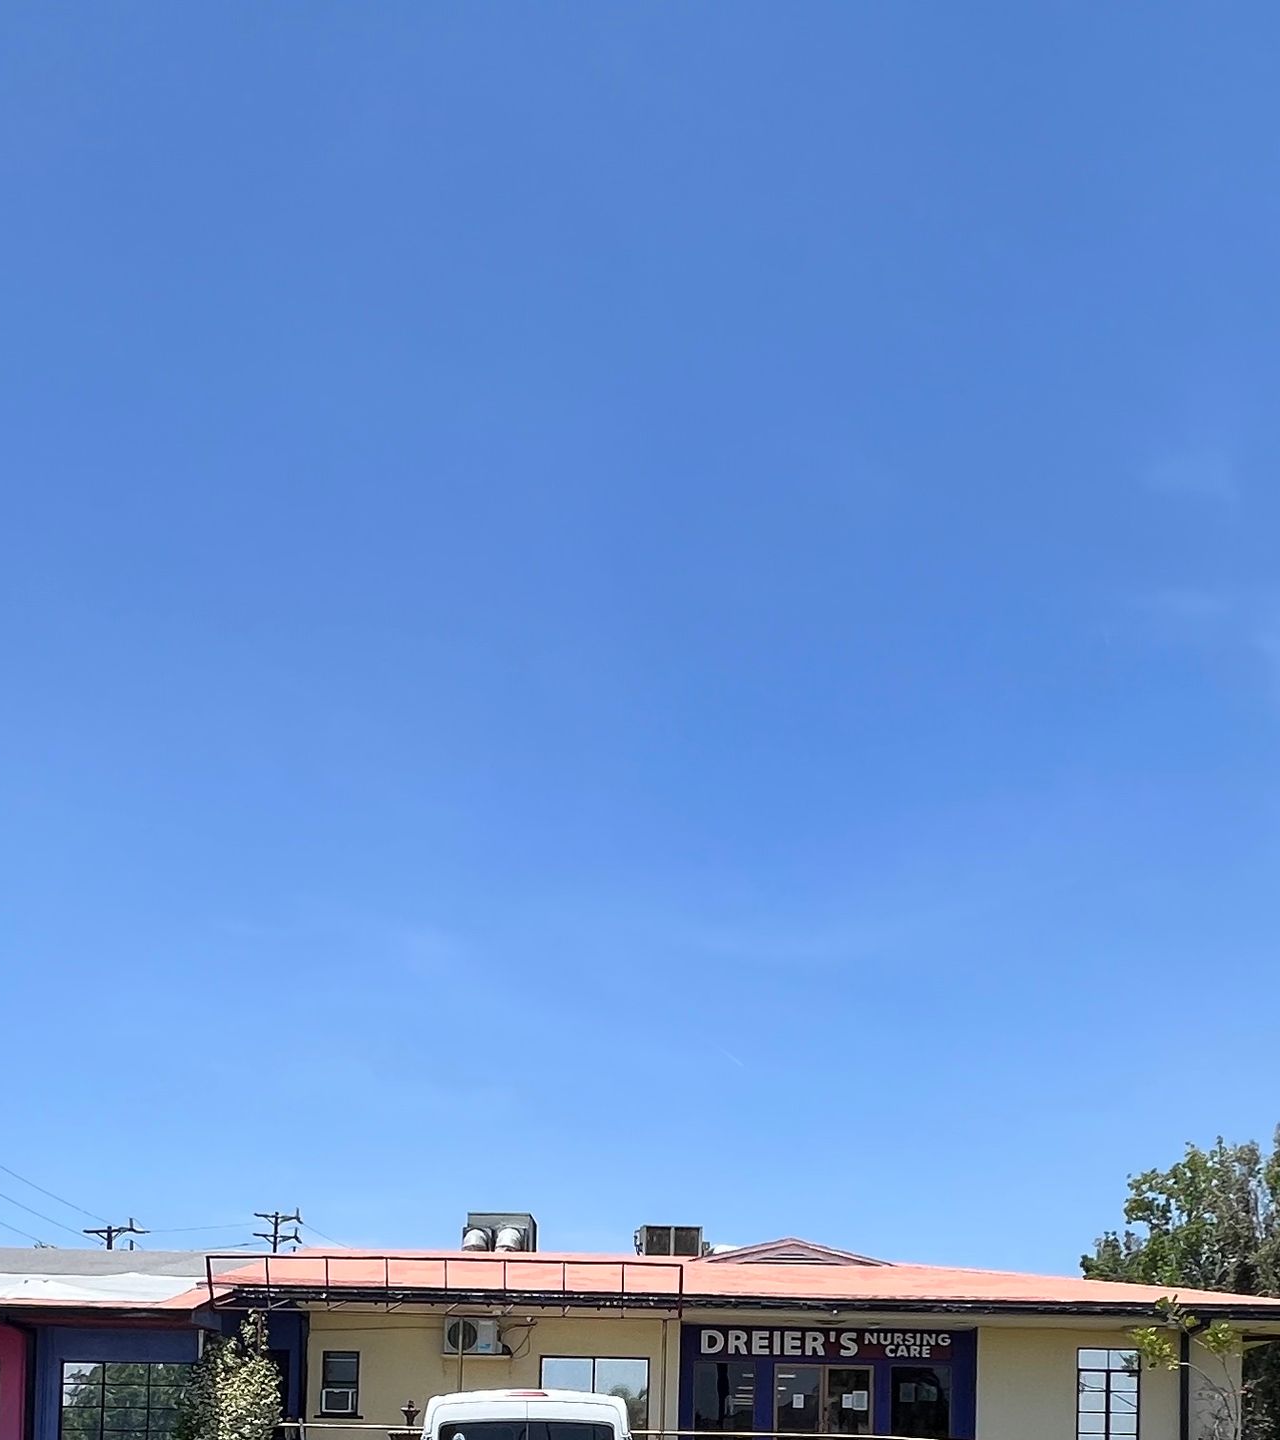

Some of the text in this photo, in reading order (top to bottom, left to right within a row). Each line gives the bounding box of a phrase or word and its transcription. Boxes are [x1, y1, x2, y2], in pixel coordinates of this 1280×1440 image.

[700, 1329, 951, 1357] DREIER'S NURSING
[885, 1345, 931, 1358] CARE
